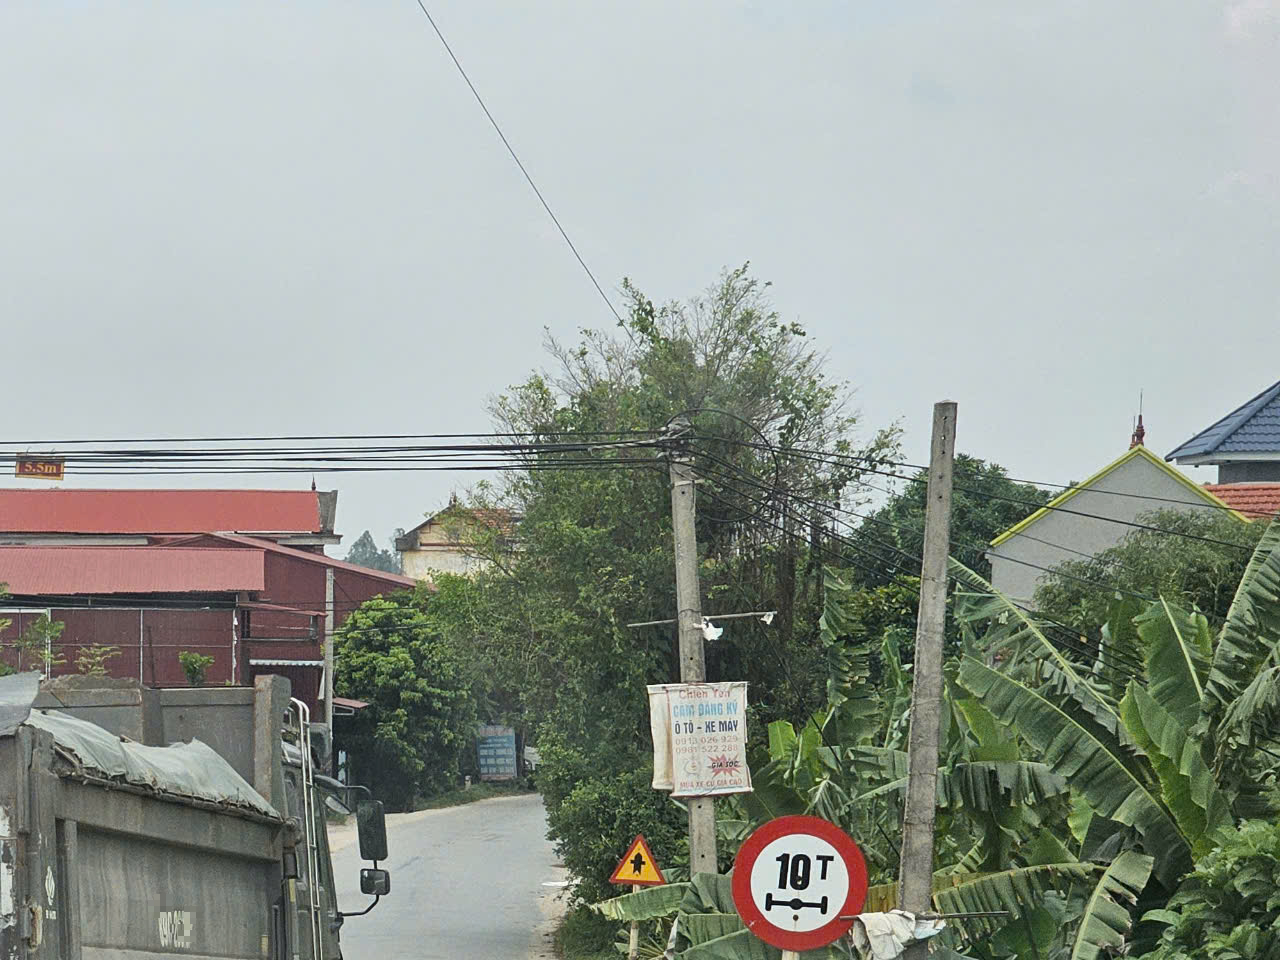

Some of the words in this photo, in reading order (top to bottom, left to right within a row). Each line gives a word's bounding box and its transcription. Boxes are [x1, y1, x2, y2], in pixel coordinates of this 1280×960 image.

[24, 461, 57, 473] 5.5m
[675, 720, 681, 734] Ô
[683, 719, 694, 734] TÔ
[705, 719, 716, 733] XE
[718, 717, 738, 732] MÁY
[700, 736, 718, 744] 026
